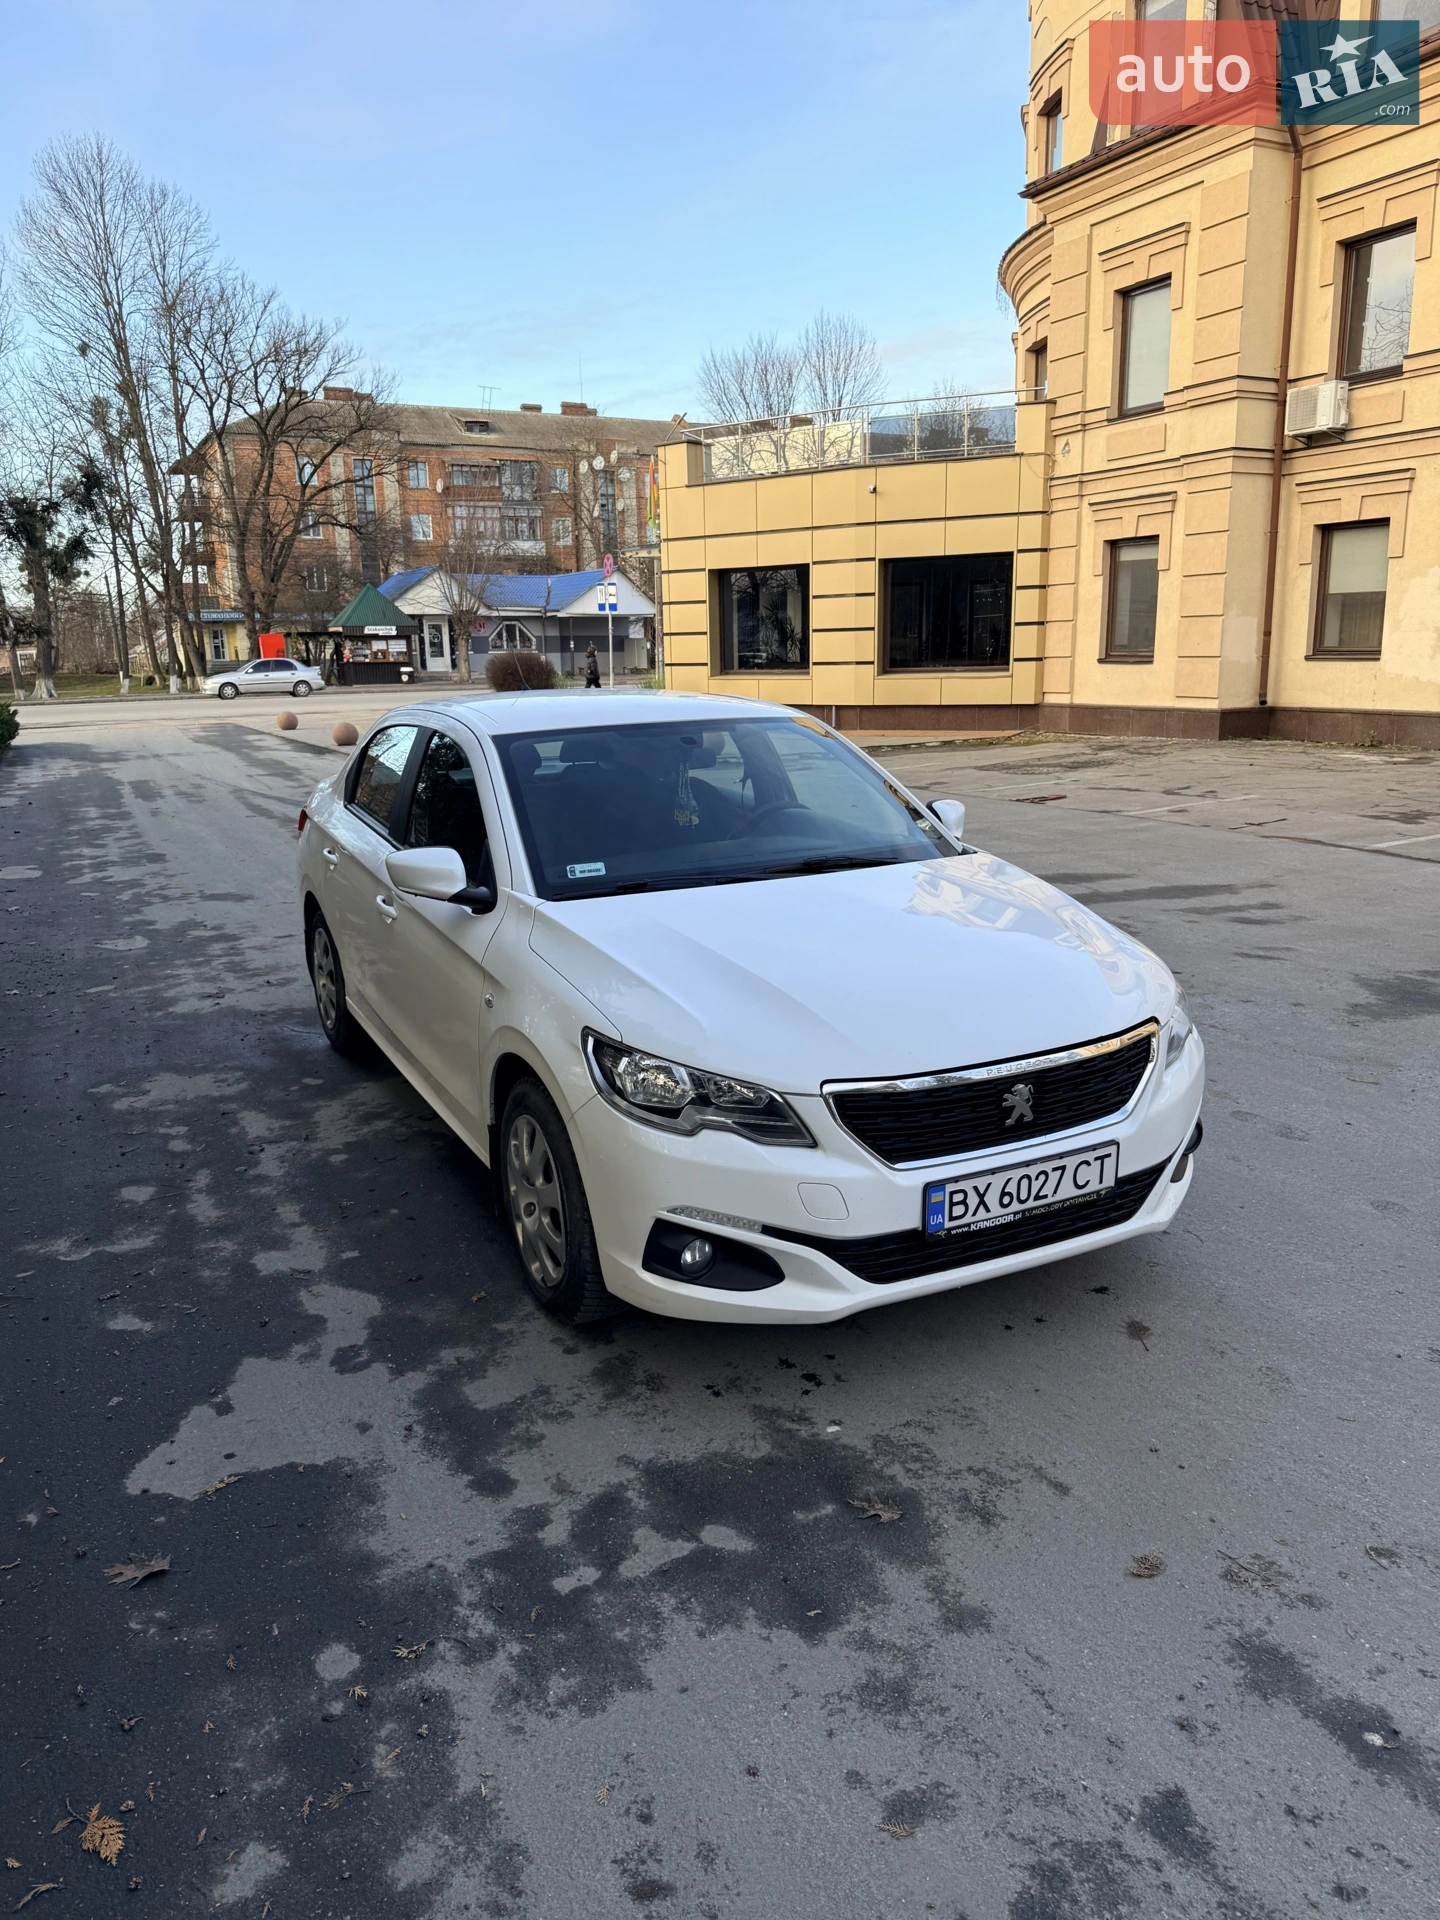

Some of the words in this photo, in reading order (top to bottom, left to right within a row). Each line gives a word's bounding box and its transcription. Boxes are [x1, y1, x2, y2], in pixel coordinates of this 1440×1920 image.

[986, 1057, 1051, 1076] PEUGEOT
[948, 1181, 992, 1222] BX
[998, 1165, 1067, 1209] 6027
[1072, 1153, 1112, 1190] CT
[930, 1213, 944, 1225] UA
